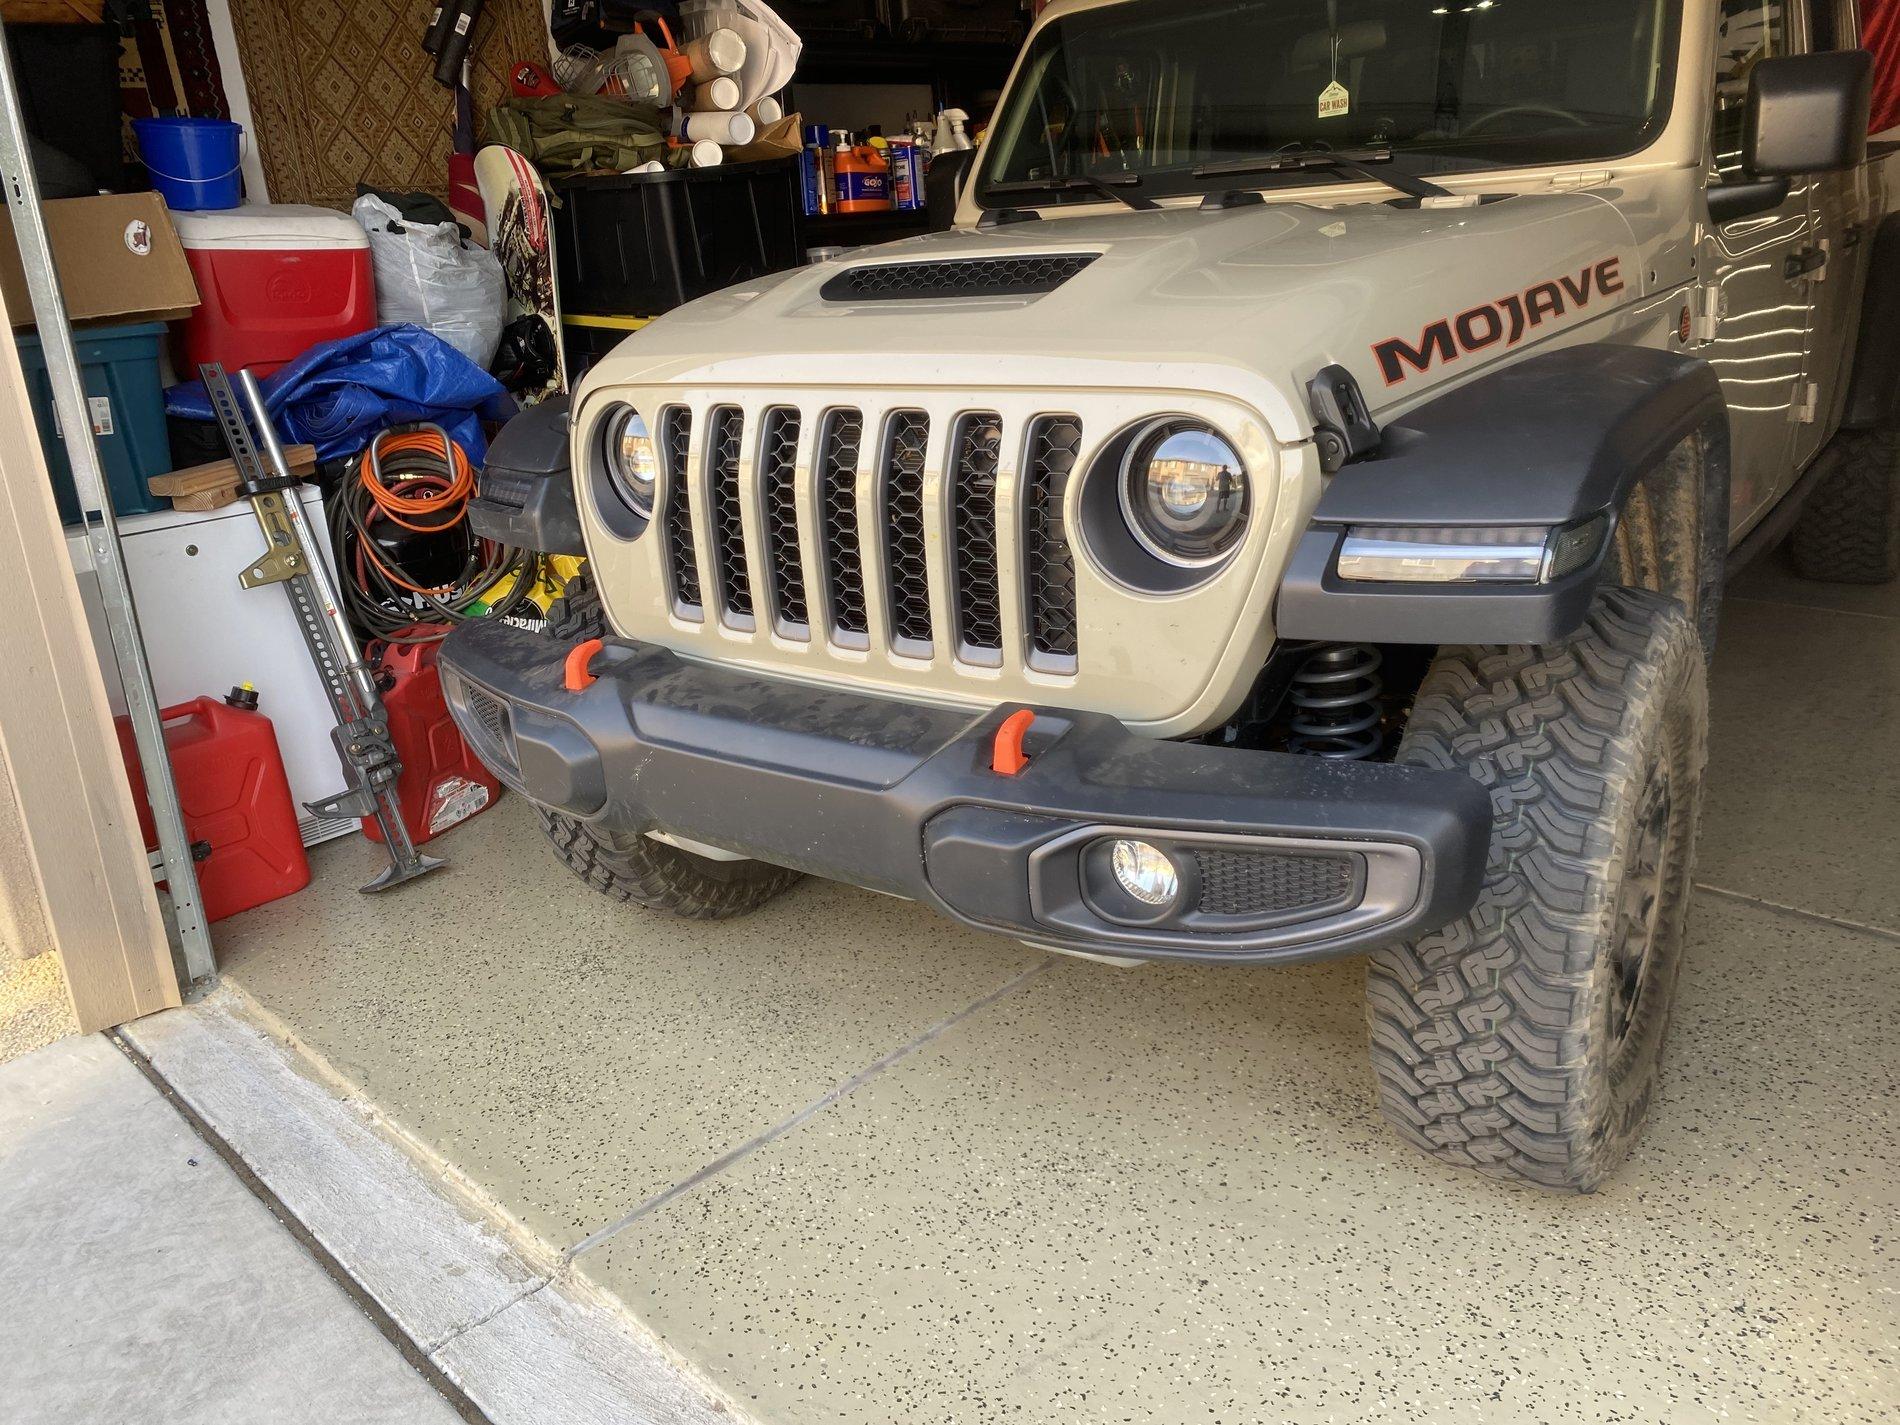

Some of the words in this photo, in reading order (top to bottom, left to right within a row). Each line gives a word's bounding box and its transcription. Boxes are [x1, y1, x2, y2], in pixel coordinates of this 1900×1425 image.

[1320, 101, 1331, 112] CAR
[1331, 98, 1348, 109] WASH
[1370, 255, 1625, 387] MOJAVE
